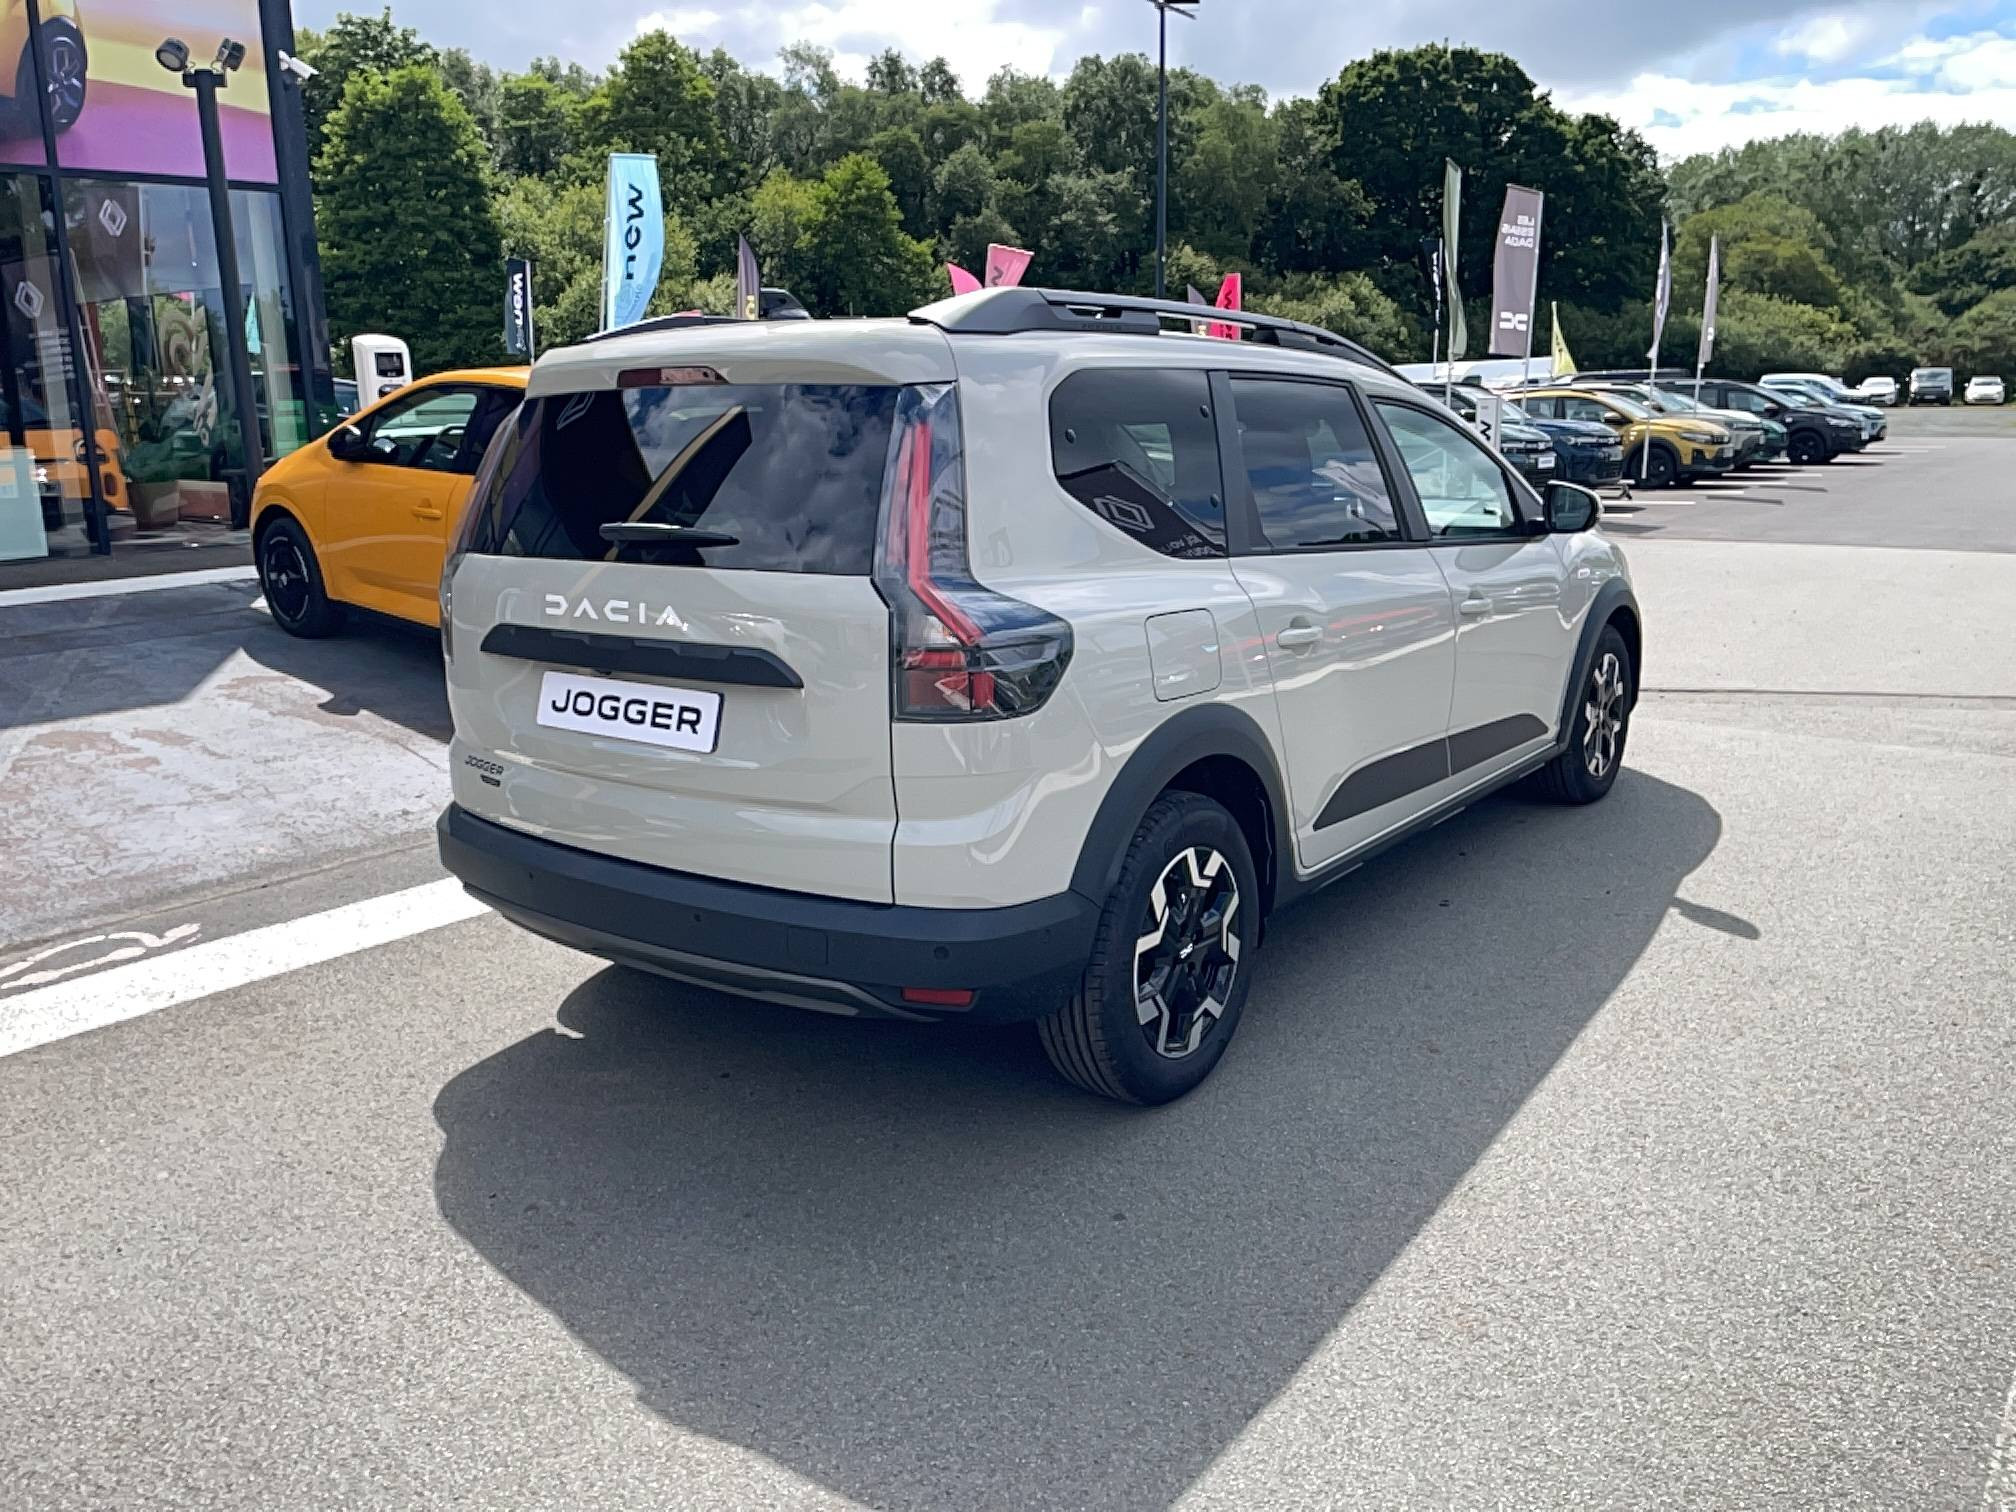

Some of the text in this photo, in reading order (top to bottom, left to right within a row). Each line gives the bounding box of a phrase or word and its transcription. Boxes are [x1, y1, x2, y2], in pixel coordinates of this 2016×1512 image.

[545, 593, 684, 627] DACIA
[551, 689, 702, 735] JOGGER
[464, 755, 504, 775] JOGGER
